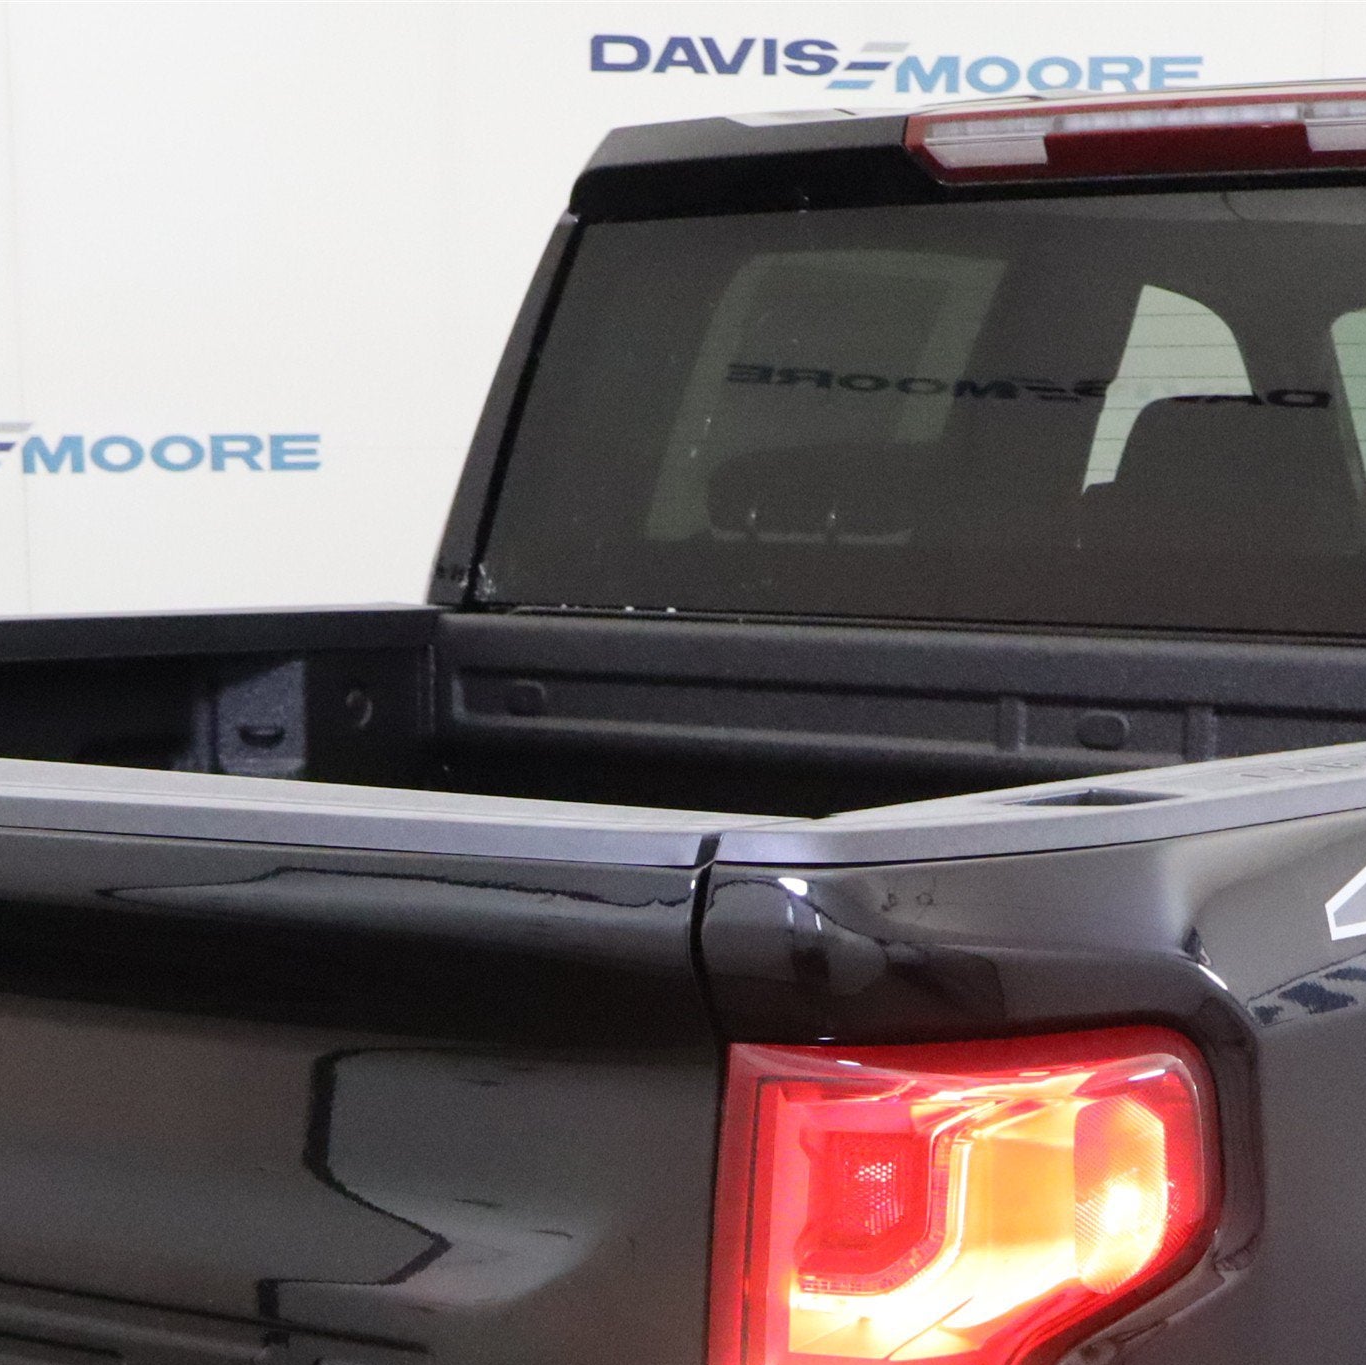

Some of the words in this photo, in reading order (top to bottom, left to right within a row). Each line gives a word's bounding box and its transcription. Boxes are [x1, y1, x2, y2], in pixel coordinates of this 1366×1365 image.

[588, 33, 837, 78] DAVIS
[895, 54, 1205, 93] MOORE
[21, 433, 321, 474] MOORE
